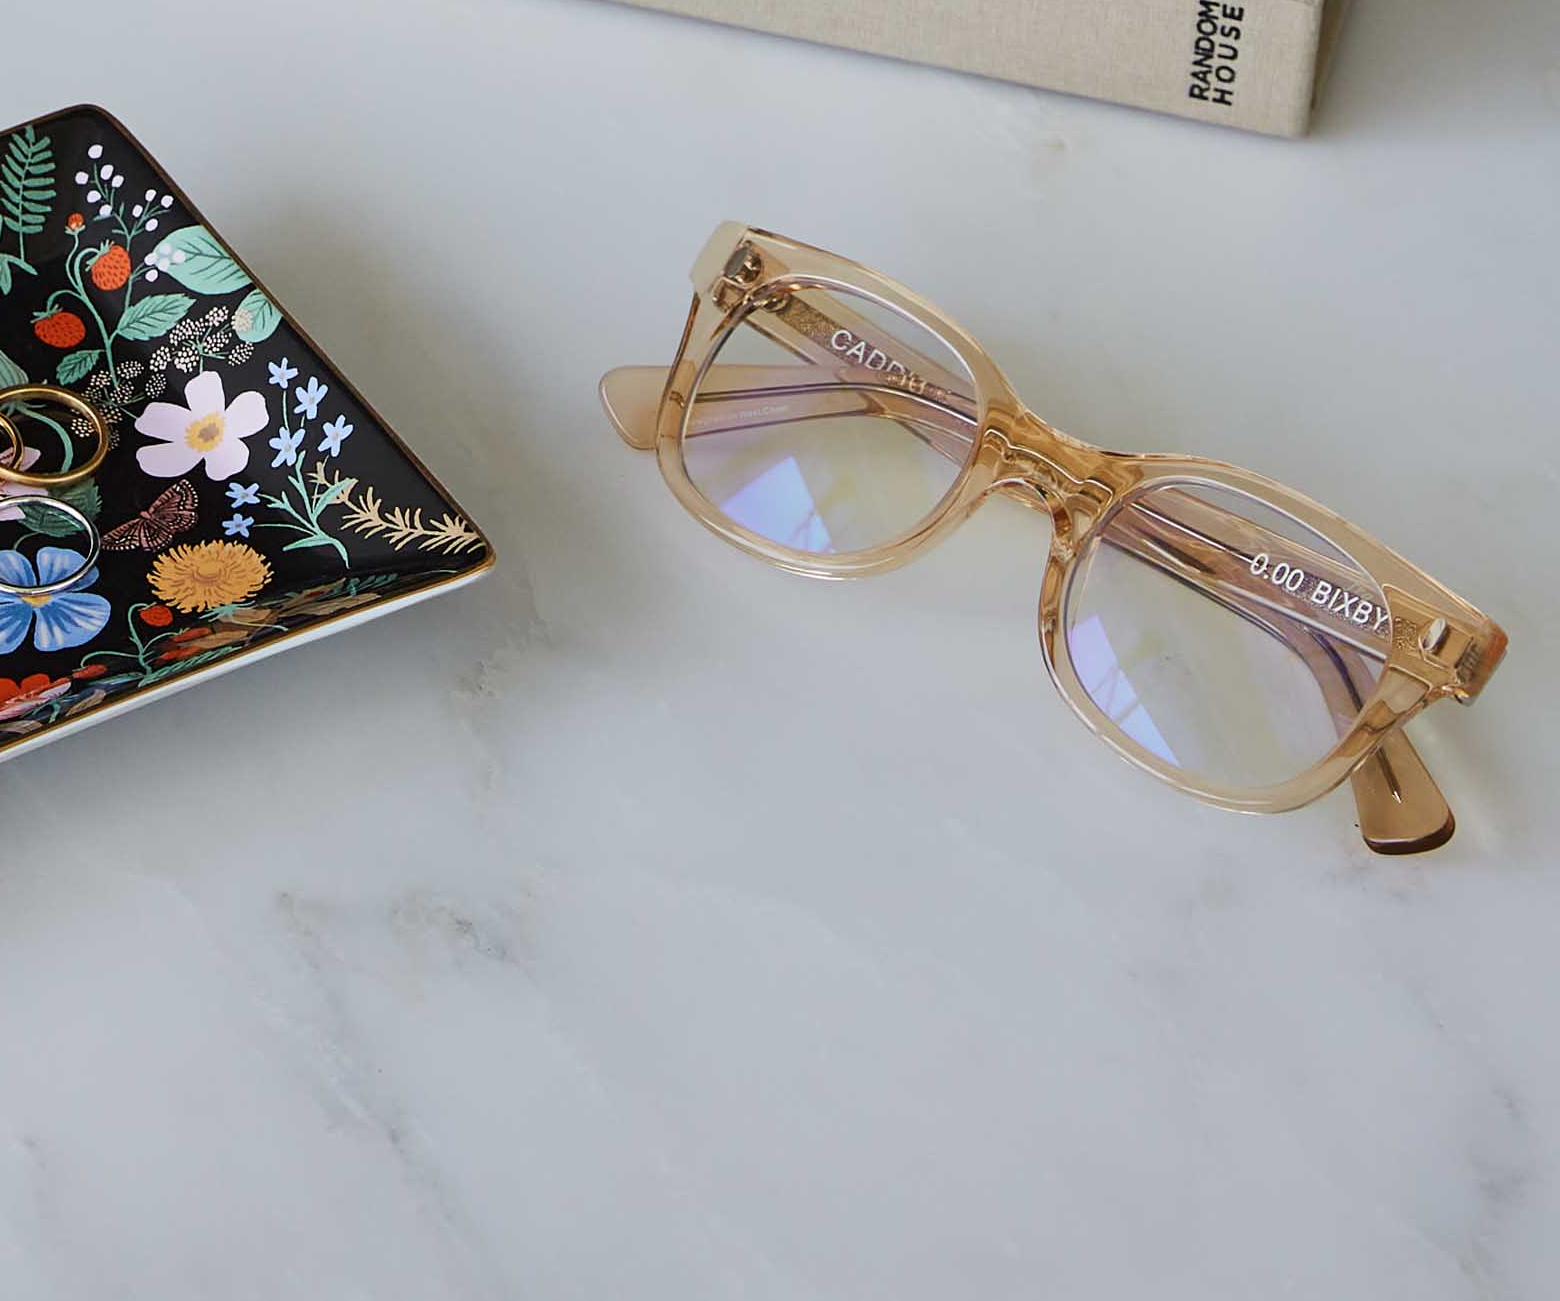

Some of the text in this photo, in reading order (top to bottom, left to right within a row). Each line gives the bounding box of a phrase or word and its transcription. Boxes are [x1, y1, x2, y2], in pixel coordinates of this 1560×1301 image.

[1189, 0, 1220, 101] RANDOM
[1212, 3, 1244, 106] HOUSE
[1249, 552, 1389, 630] 0.00 BIXBY
